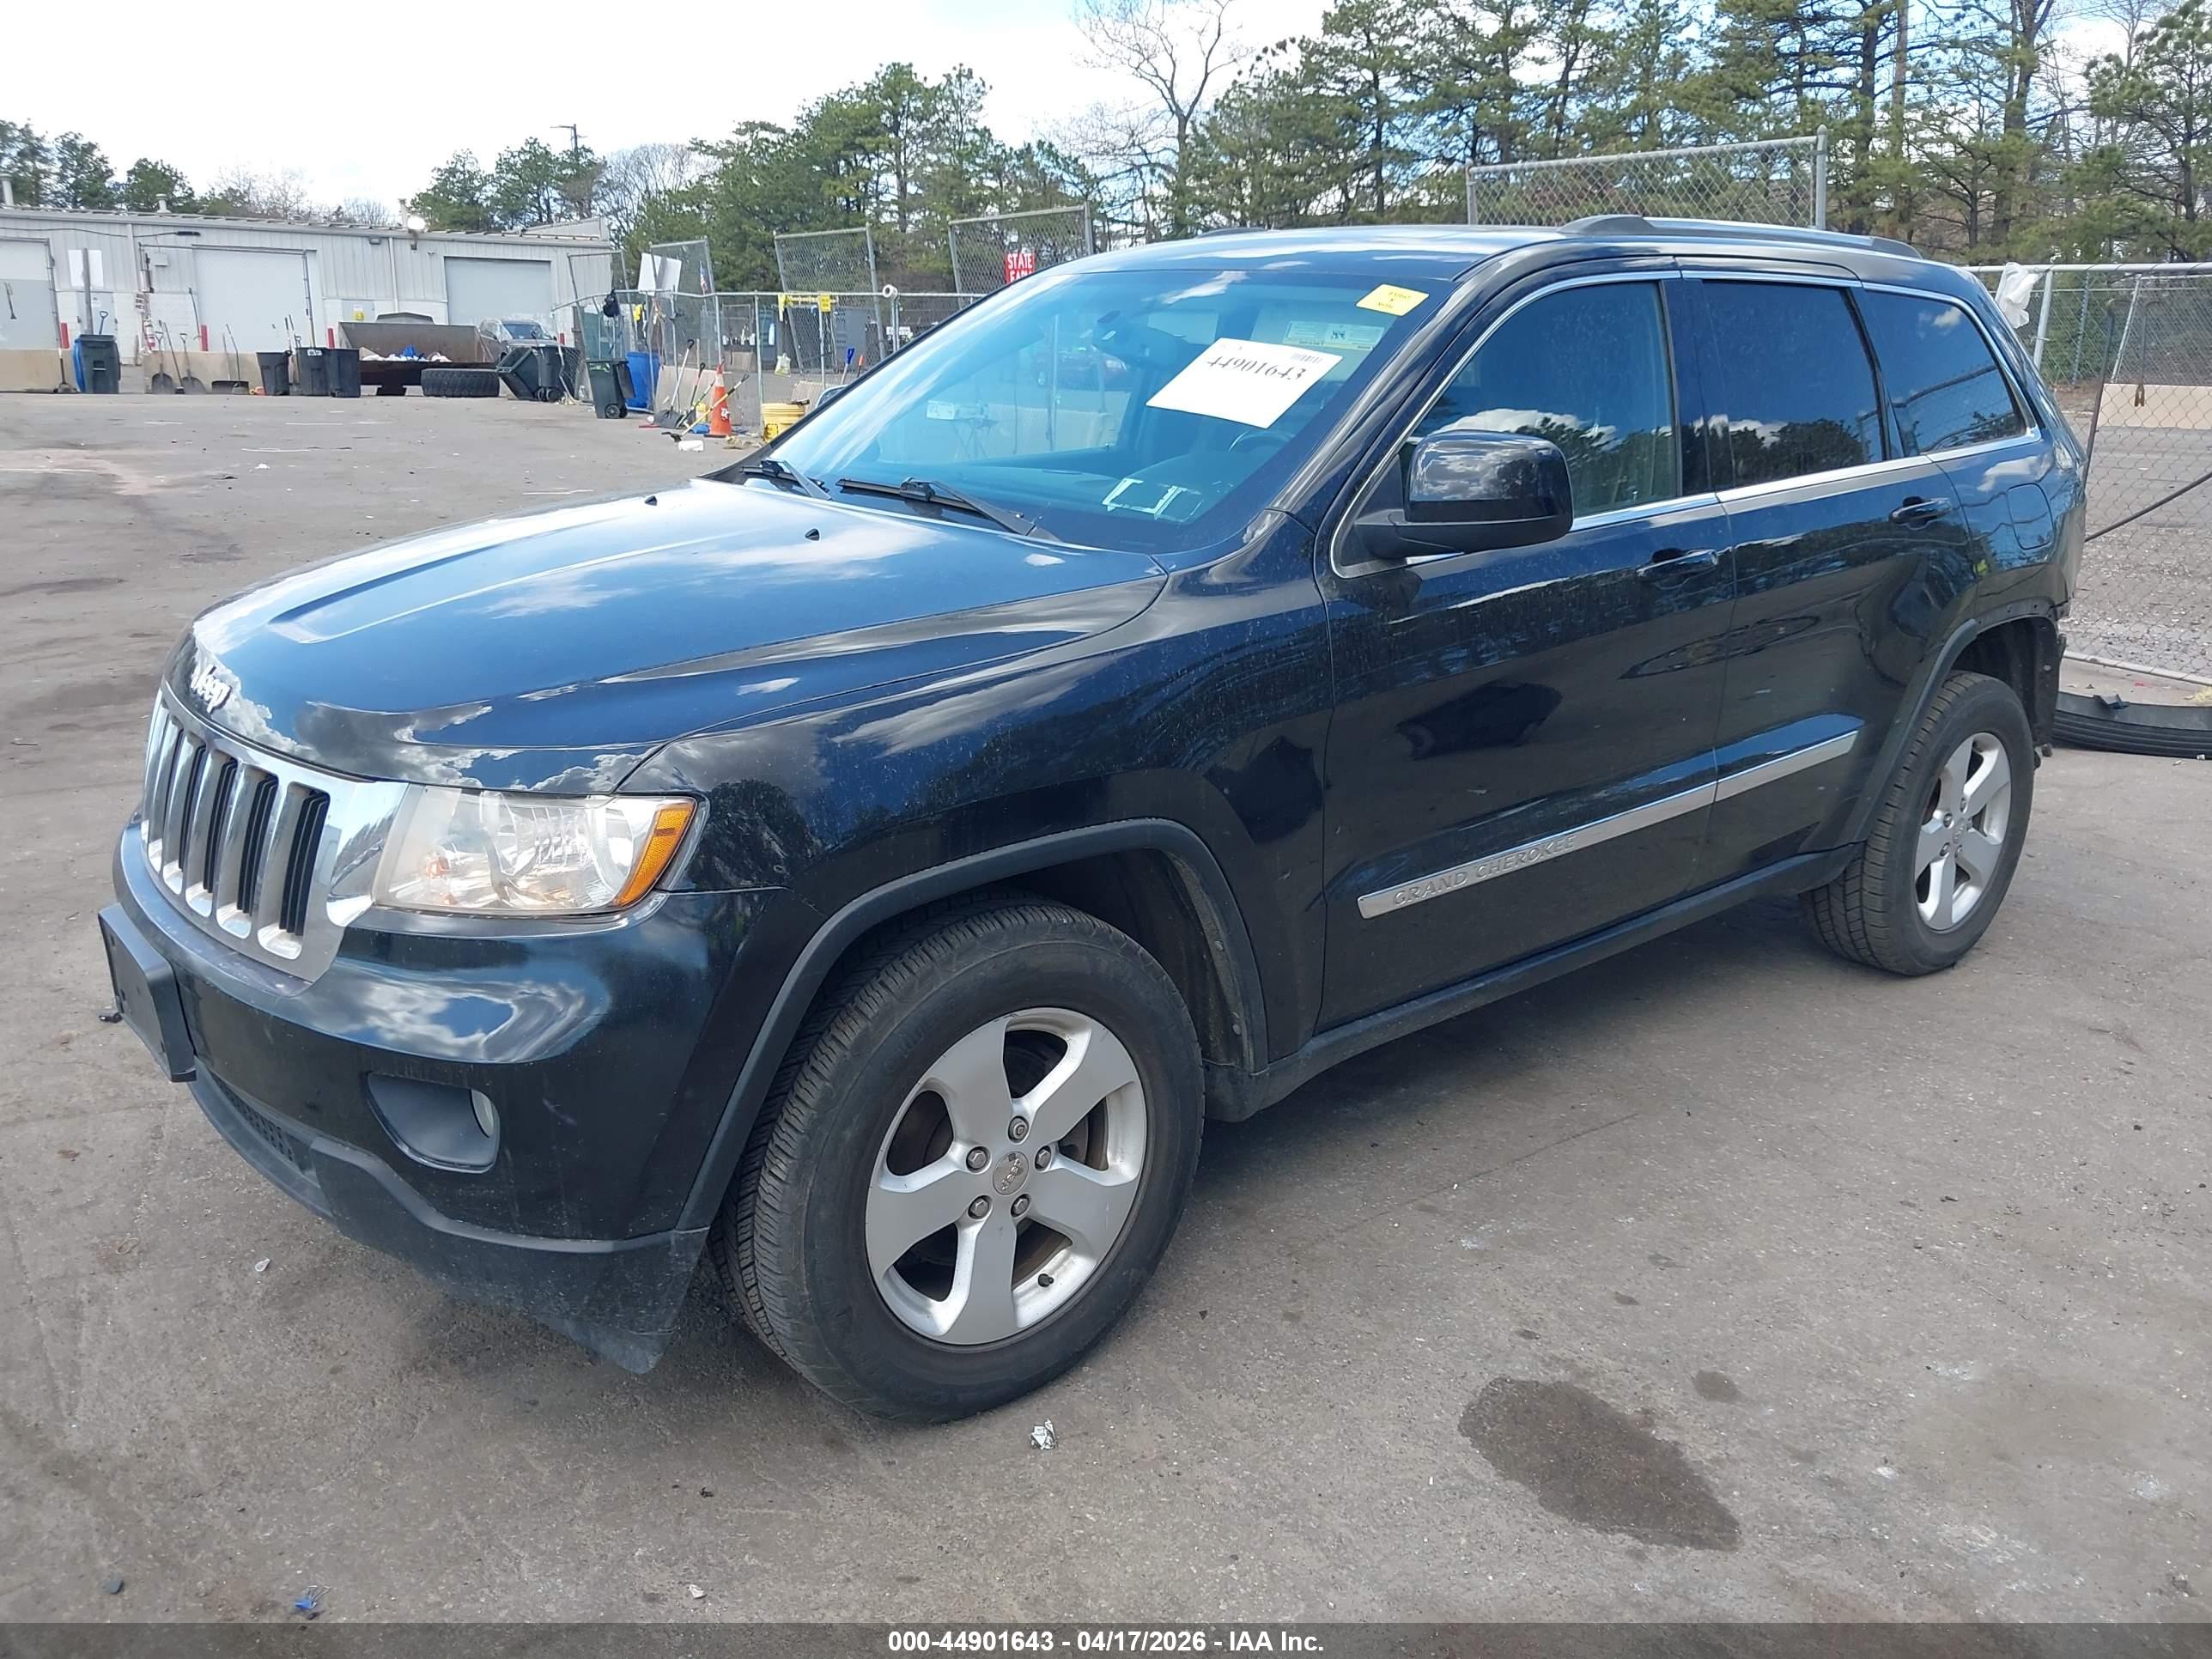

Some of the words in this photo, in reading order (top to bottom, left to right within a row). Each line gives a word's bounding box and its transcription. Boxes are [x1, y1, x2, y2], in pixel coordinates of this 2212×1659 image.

[1007, 252, 1033, 270] STATE
[1207, 356, 1307, 380] 44901643
[1393, 871, 1469, 907] GRAND
[1475, 835, 1577, 880] CHEROKEE
